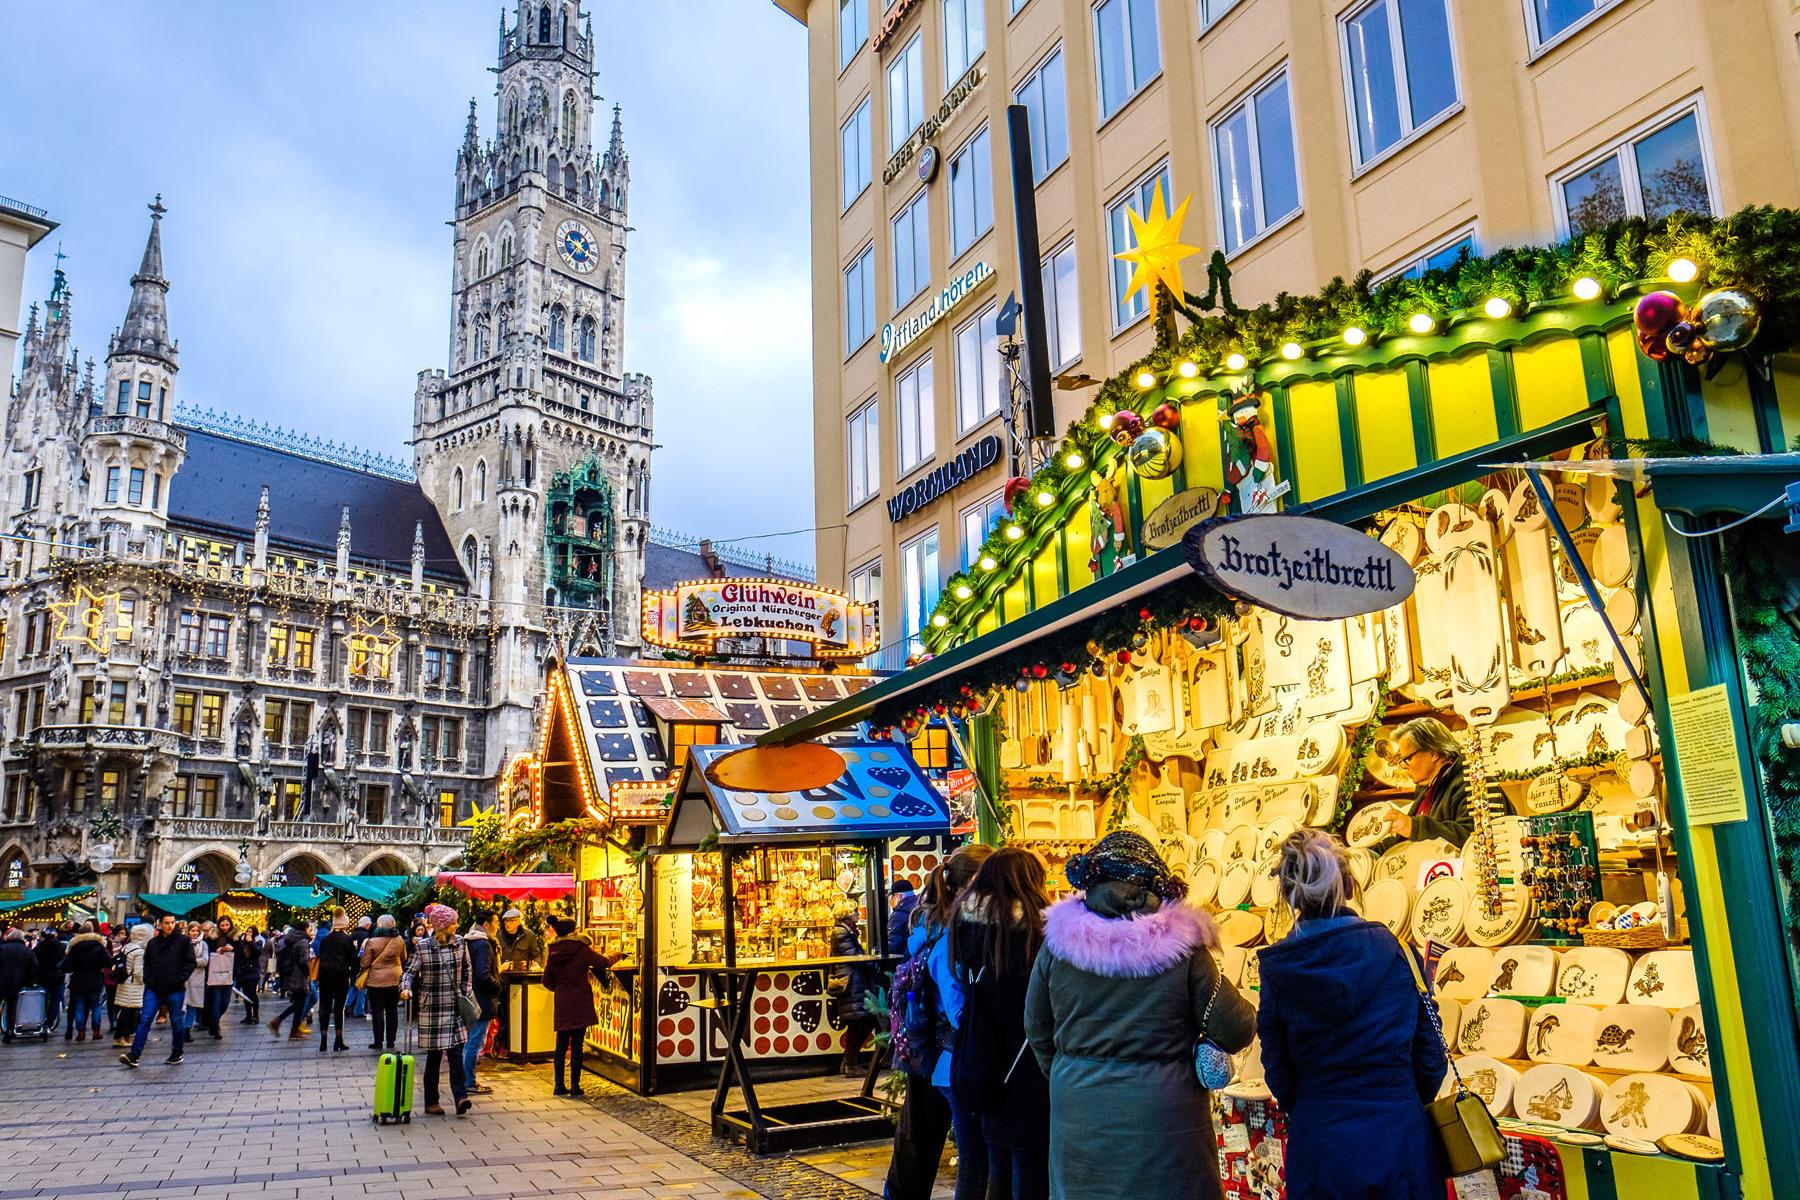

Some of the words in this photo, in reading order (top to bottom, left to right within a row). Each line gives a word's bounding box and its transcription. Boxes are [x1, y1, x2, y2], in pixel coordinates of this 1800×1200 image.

[886, 435, 1002, 524] WORMLAND
[1148, 491, 1210, 541] Brotzeitbrettl
[1217, 533, 1397, 592] Brotzeitbrettl
[721, 583, 816, 610] Glühwein
[712, 603, 756, 614] Original
[762, 604, 822, 620] Nürnberger
[720, 616, 816, 633] Lebkuchen
[175, 881, 193, 890] GER
[176, 873, 191, 881] ZIN
